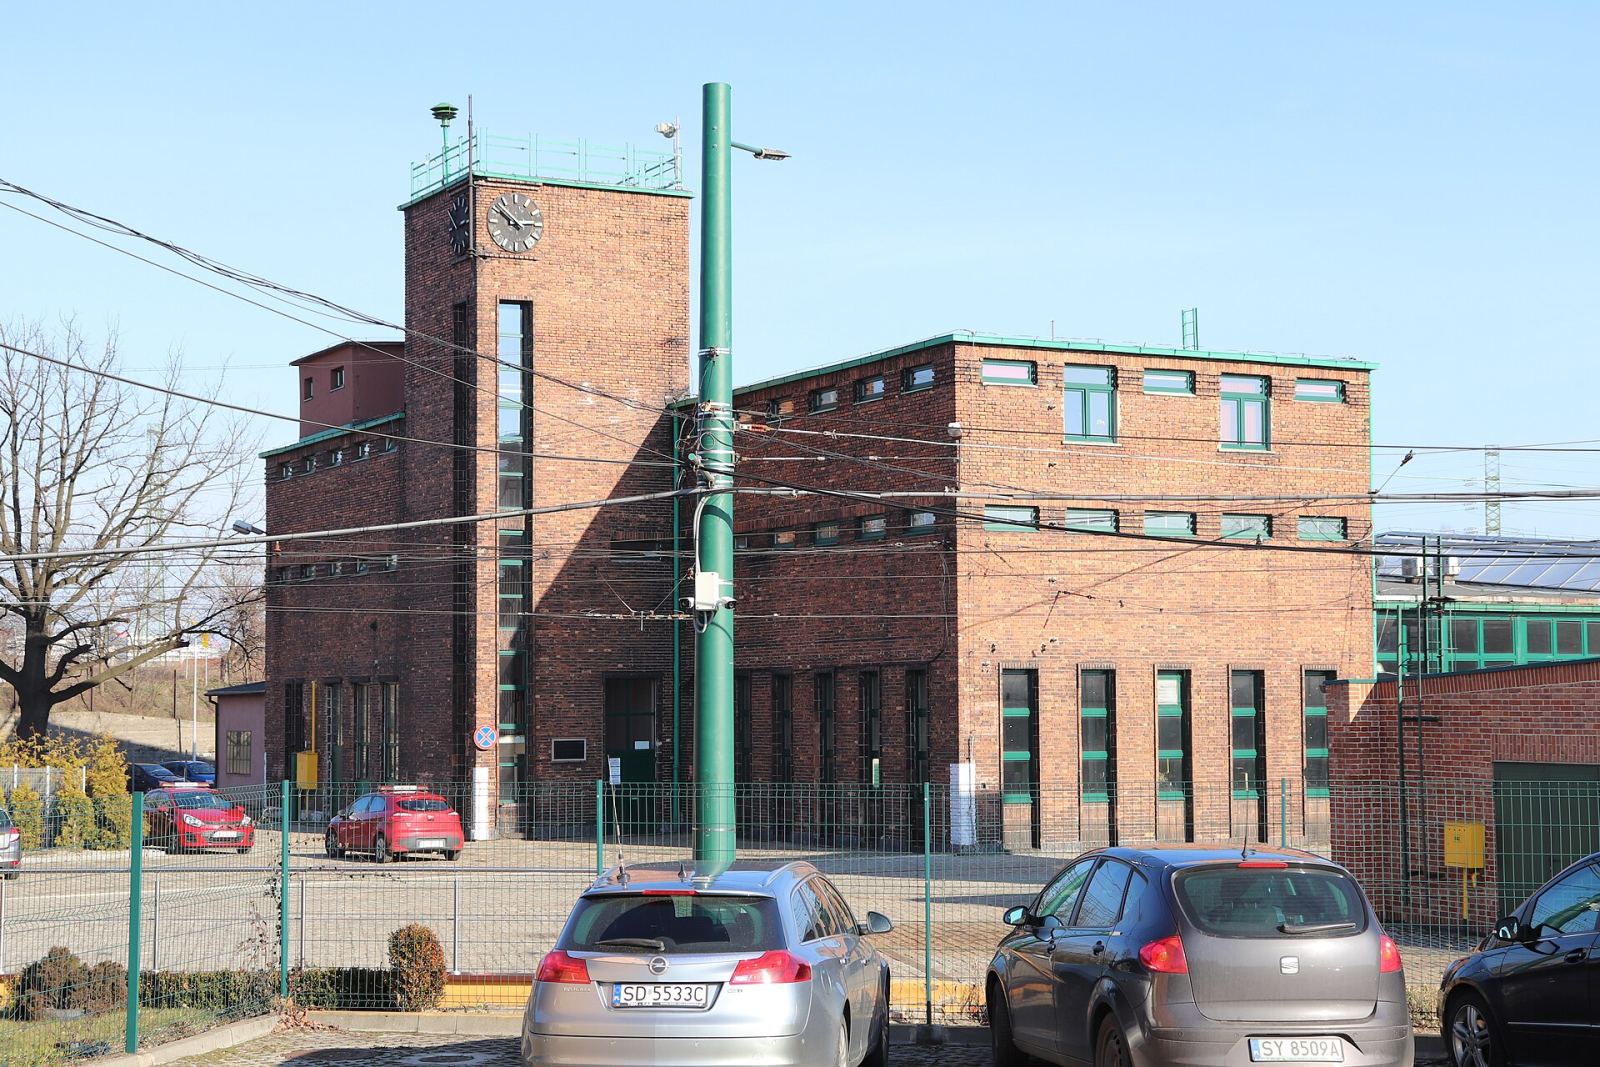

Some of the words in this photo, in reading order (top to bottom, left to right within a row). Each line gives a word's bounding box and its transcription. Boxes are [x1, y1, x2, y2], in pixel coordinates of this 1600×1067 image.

[624, 986, 646, 1001] SD
[653, 986, 704, 1001] 5533C
[1262, 1041, 1283, 1056] SY
[1290, 1041, 1339, 1056] 8509A
